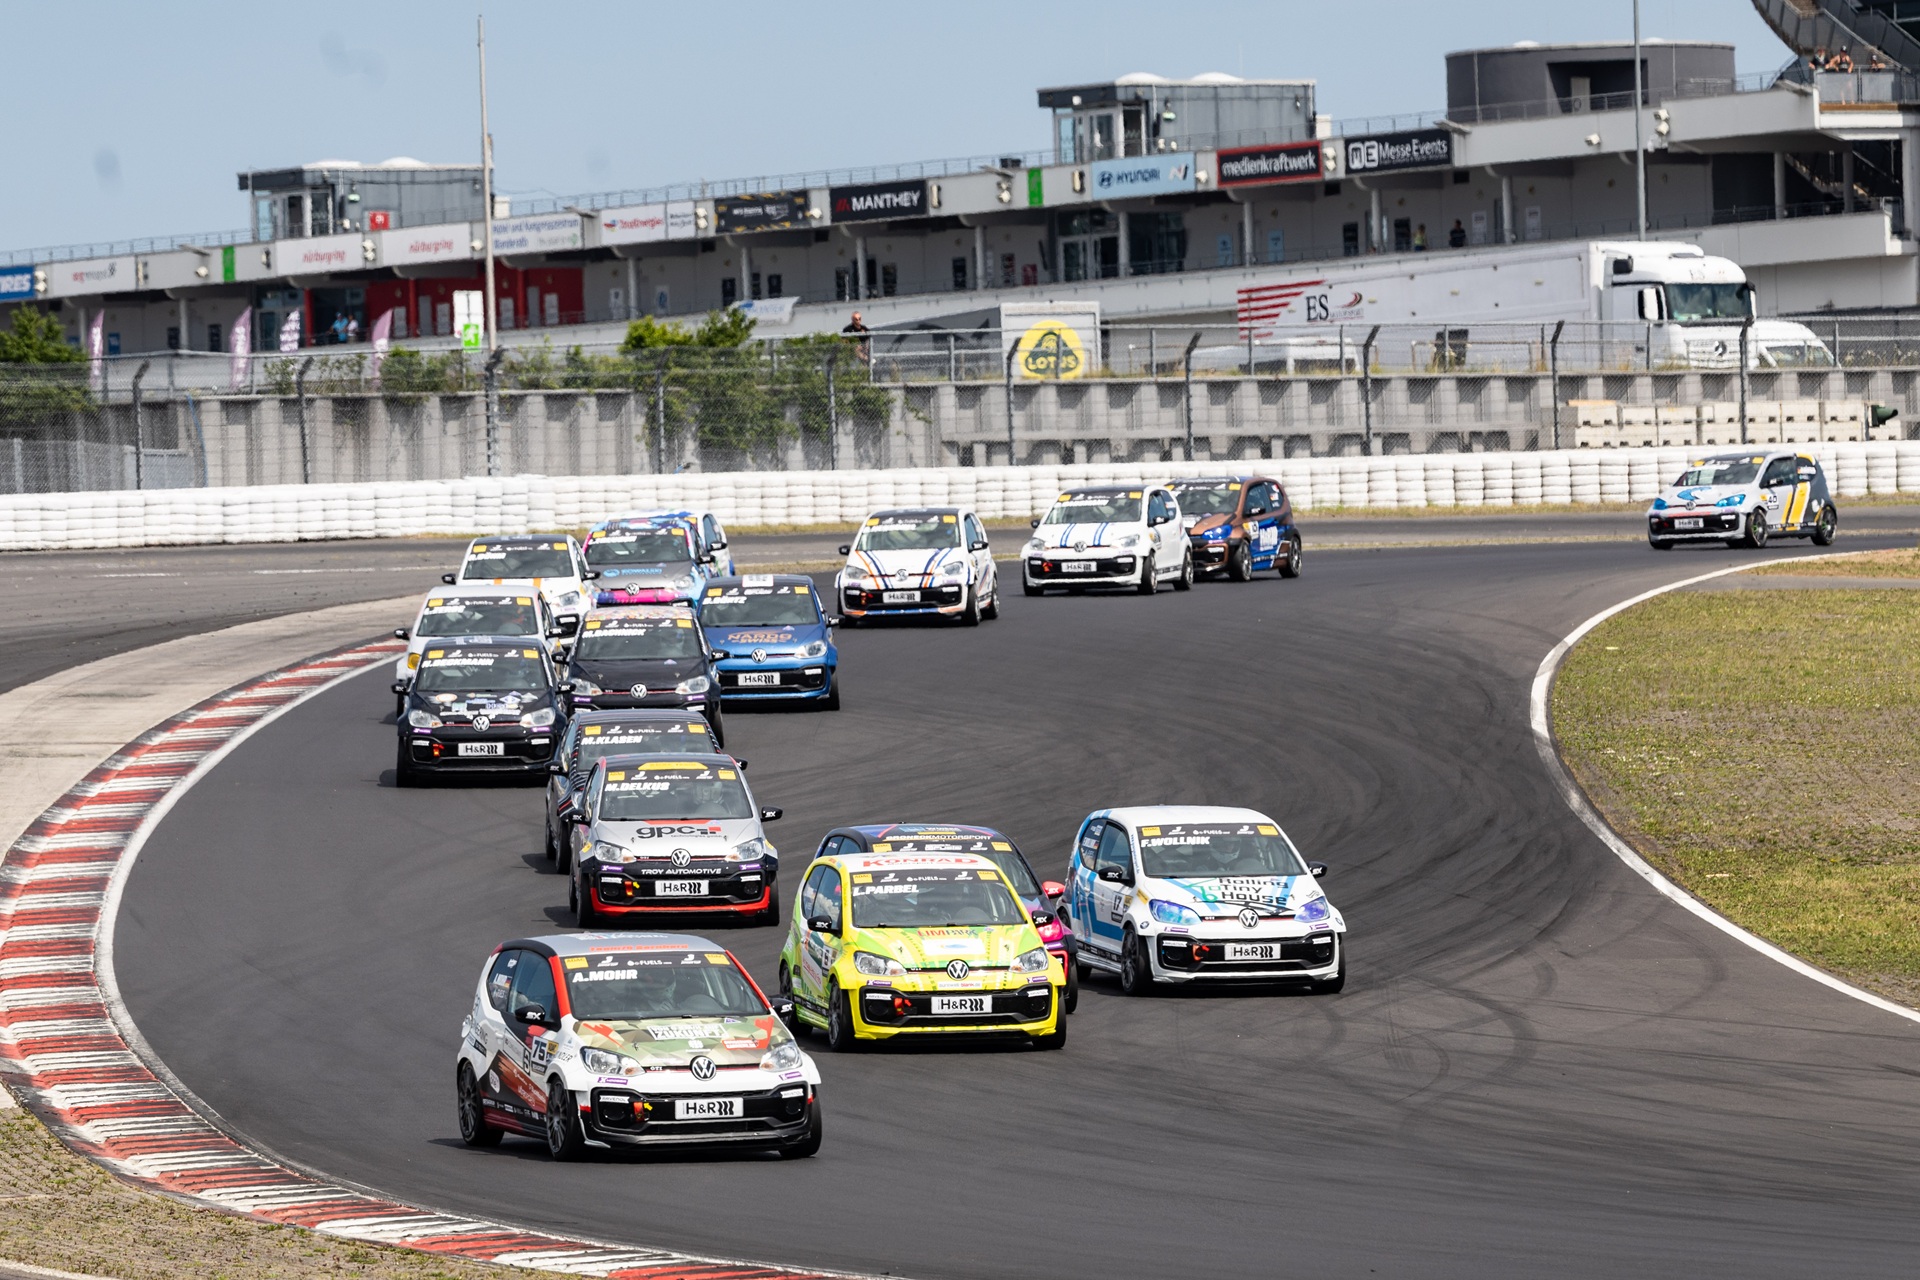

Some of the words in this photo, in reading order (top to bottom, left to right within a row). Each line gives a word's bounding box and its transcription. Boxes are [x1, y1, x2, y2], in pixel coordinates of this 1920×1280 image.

[1221, 150, 1317, 177] medienkraftwerk
[1115, 170, 1161, 185] HYUNDAI
[851, 190, 920, 212] MANTHEY
[1305, 294, 1329, 322] ES
[744, 675, 764, 683] H&R
[465, 744, 486, 754] H&R
[604, 782, 670, 792] M.DELKUS
[636, 826, 695, 839] gpc
[1141, 836, 1211, 848] F.WOLLNIK
[863, 858, 979, 867] KONRAD
[664, 883, 687, 893] H&R
[1219, 878, 1289, 889] Rolling
[1220, 884, 1263, 893] Tiny
[852, 884, 920, 897] L.PARBEL
[1113, 894, 1122, 911] 17
[1221, 892, 1287, 905] House
[1233, 946, 1259, 957] H&R
[572, 969, 638, 983] A.MOHR
[941, 999, 968, 1010] H&R
[526, 1012, 541, 1020] SX
[532, 1040, 547, 1062] 75
[686, 1101, 716, 1115] H&R
